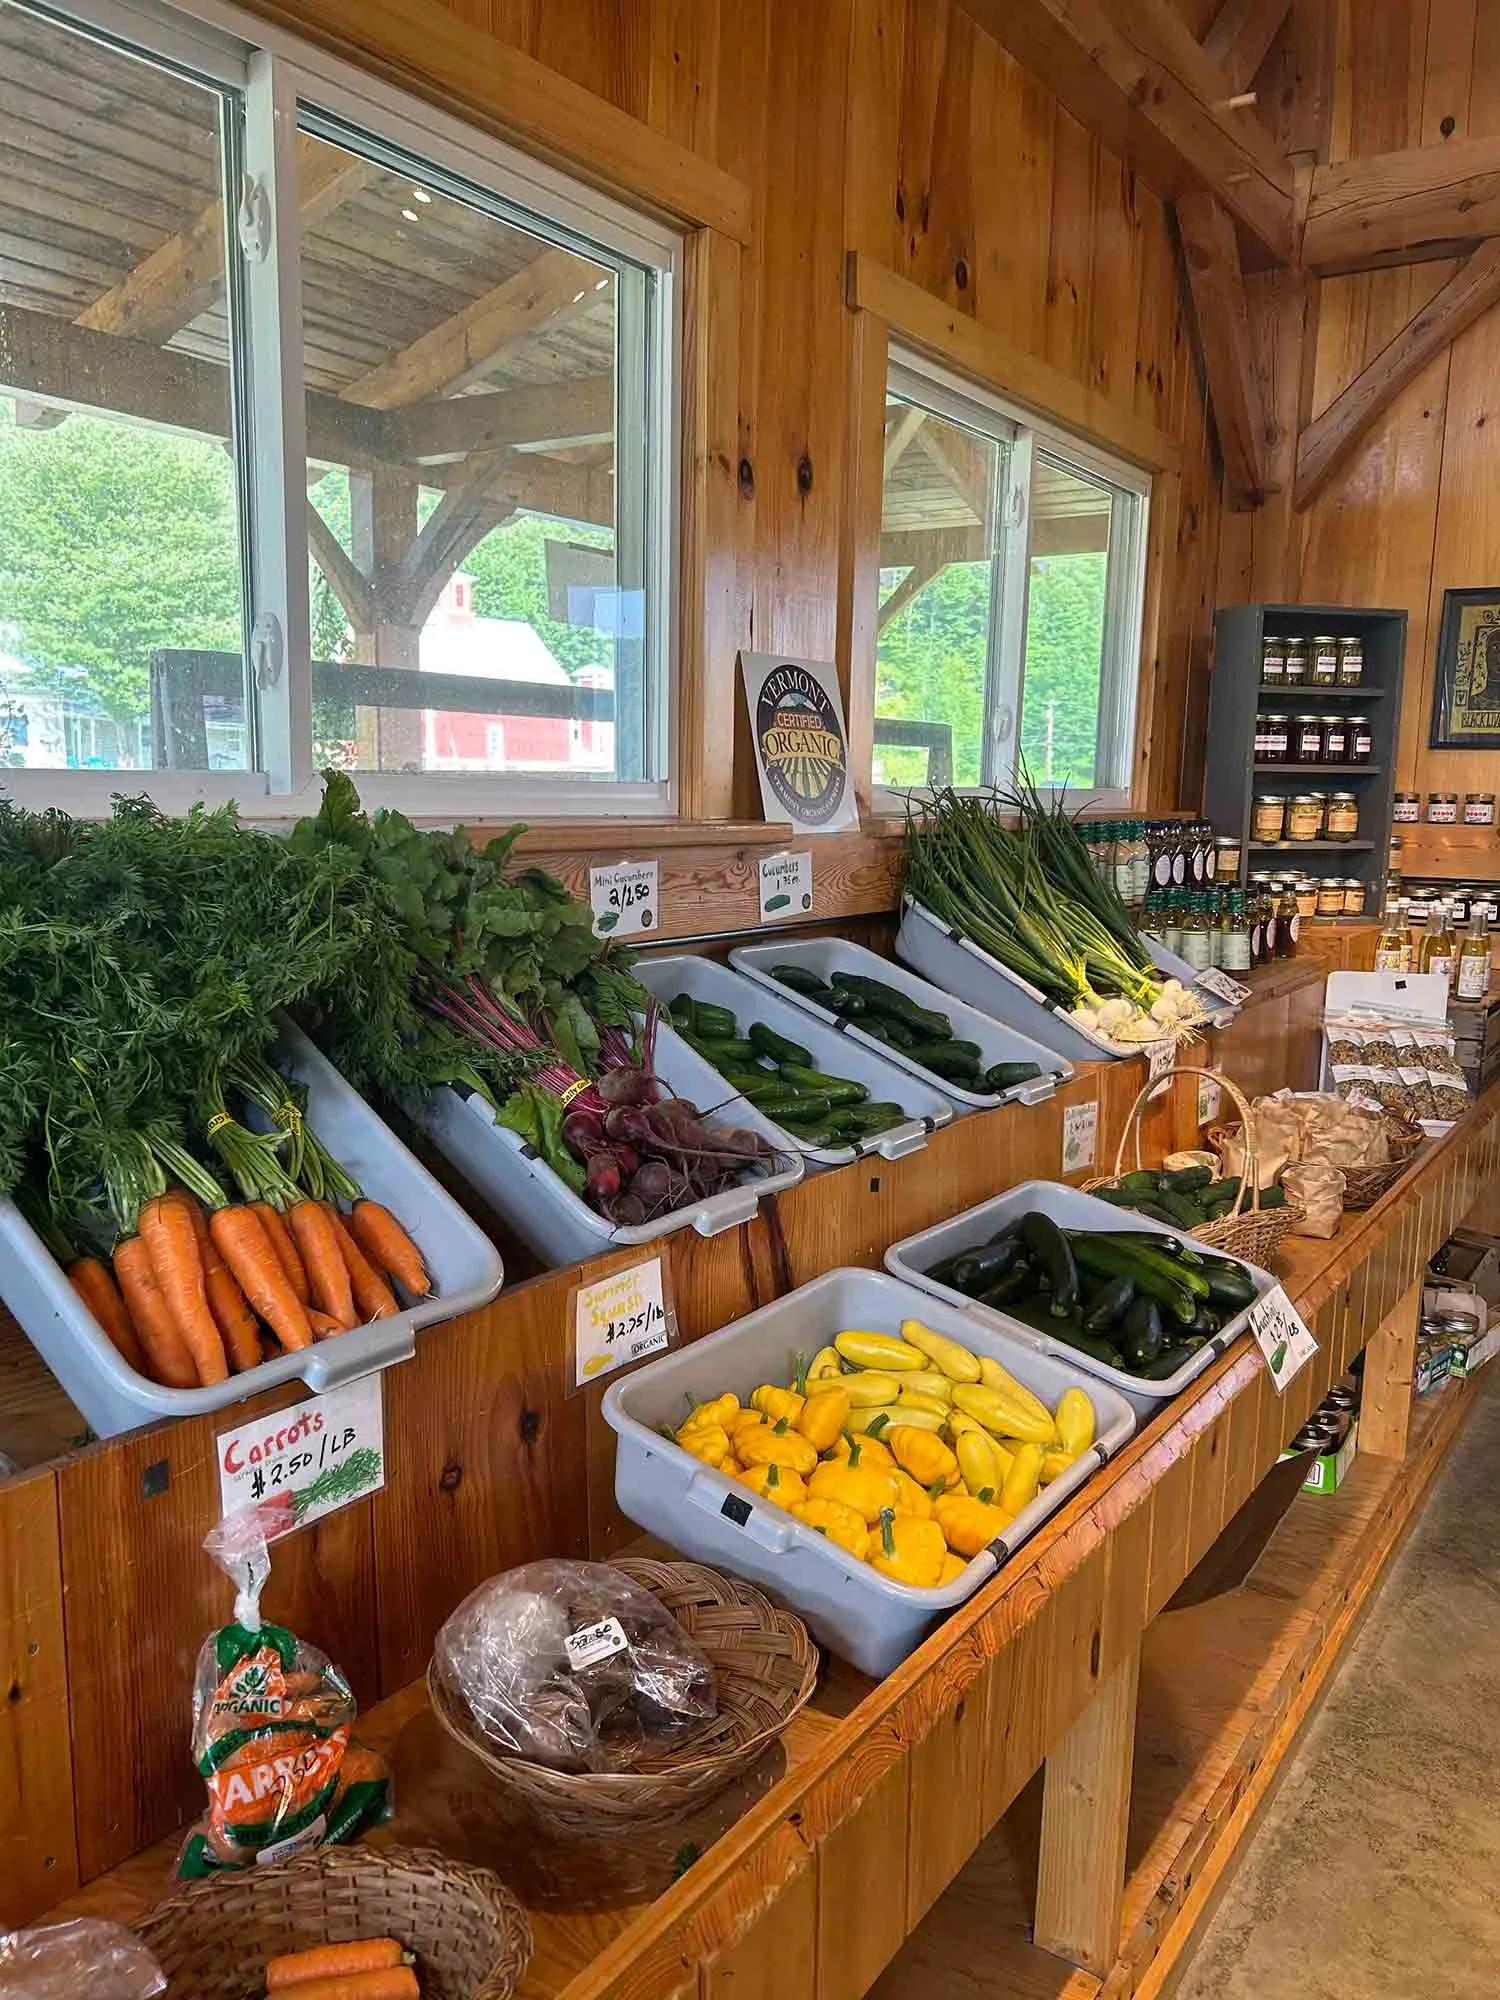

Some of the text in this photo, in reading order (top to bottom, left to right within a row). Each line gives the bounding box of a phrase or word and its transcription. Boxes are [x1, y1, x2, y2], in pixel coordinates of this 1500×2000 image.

[761, 670, 830, 714] VERMONT
[776, 712, 822, 730] CERTIFIED
[765, 732, 838, 761] ORGANIC
[594, 875, 612, 887] Mini
[632, 1335, 666, 1355] ORGANIC
[224, 1411, 325, 1474] Carrots
